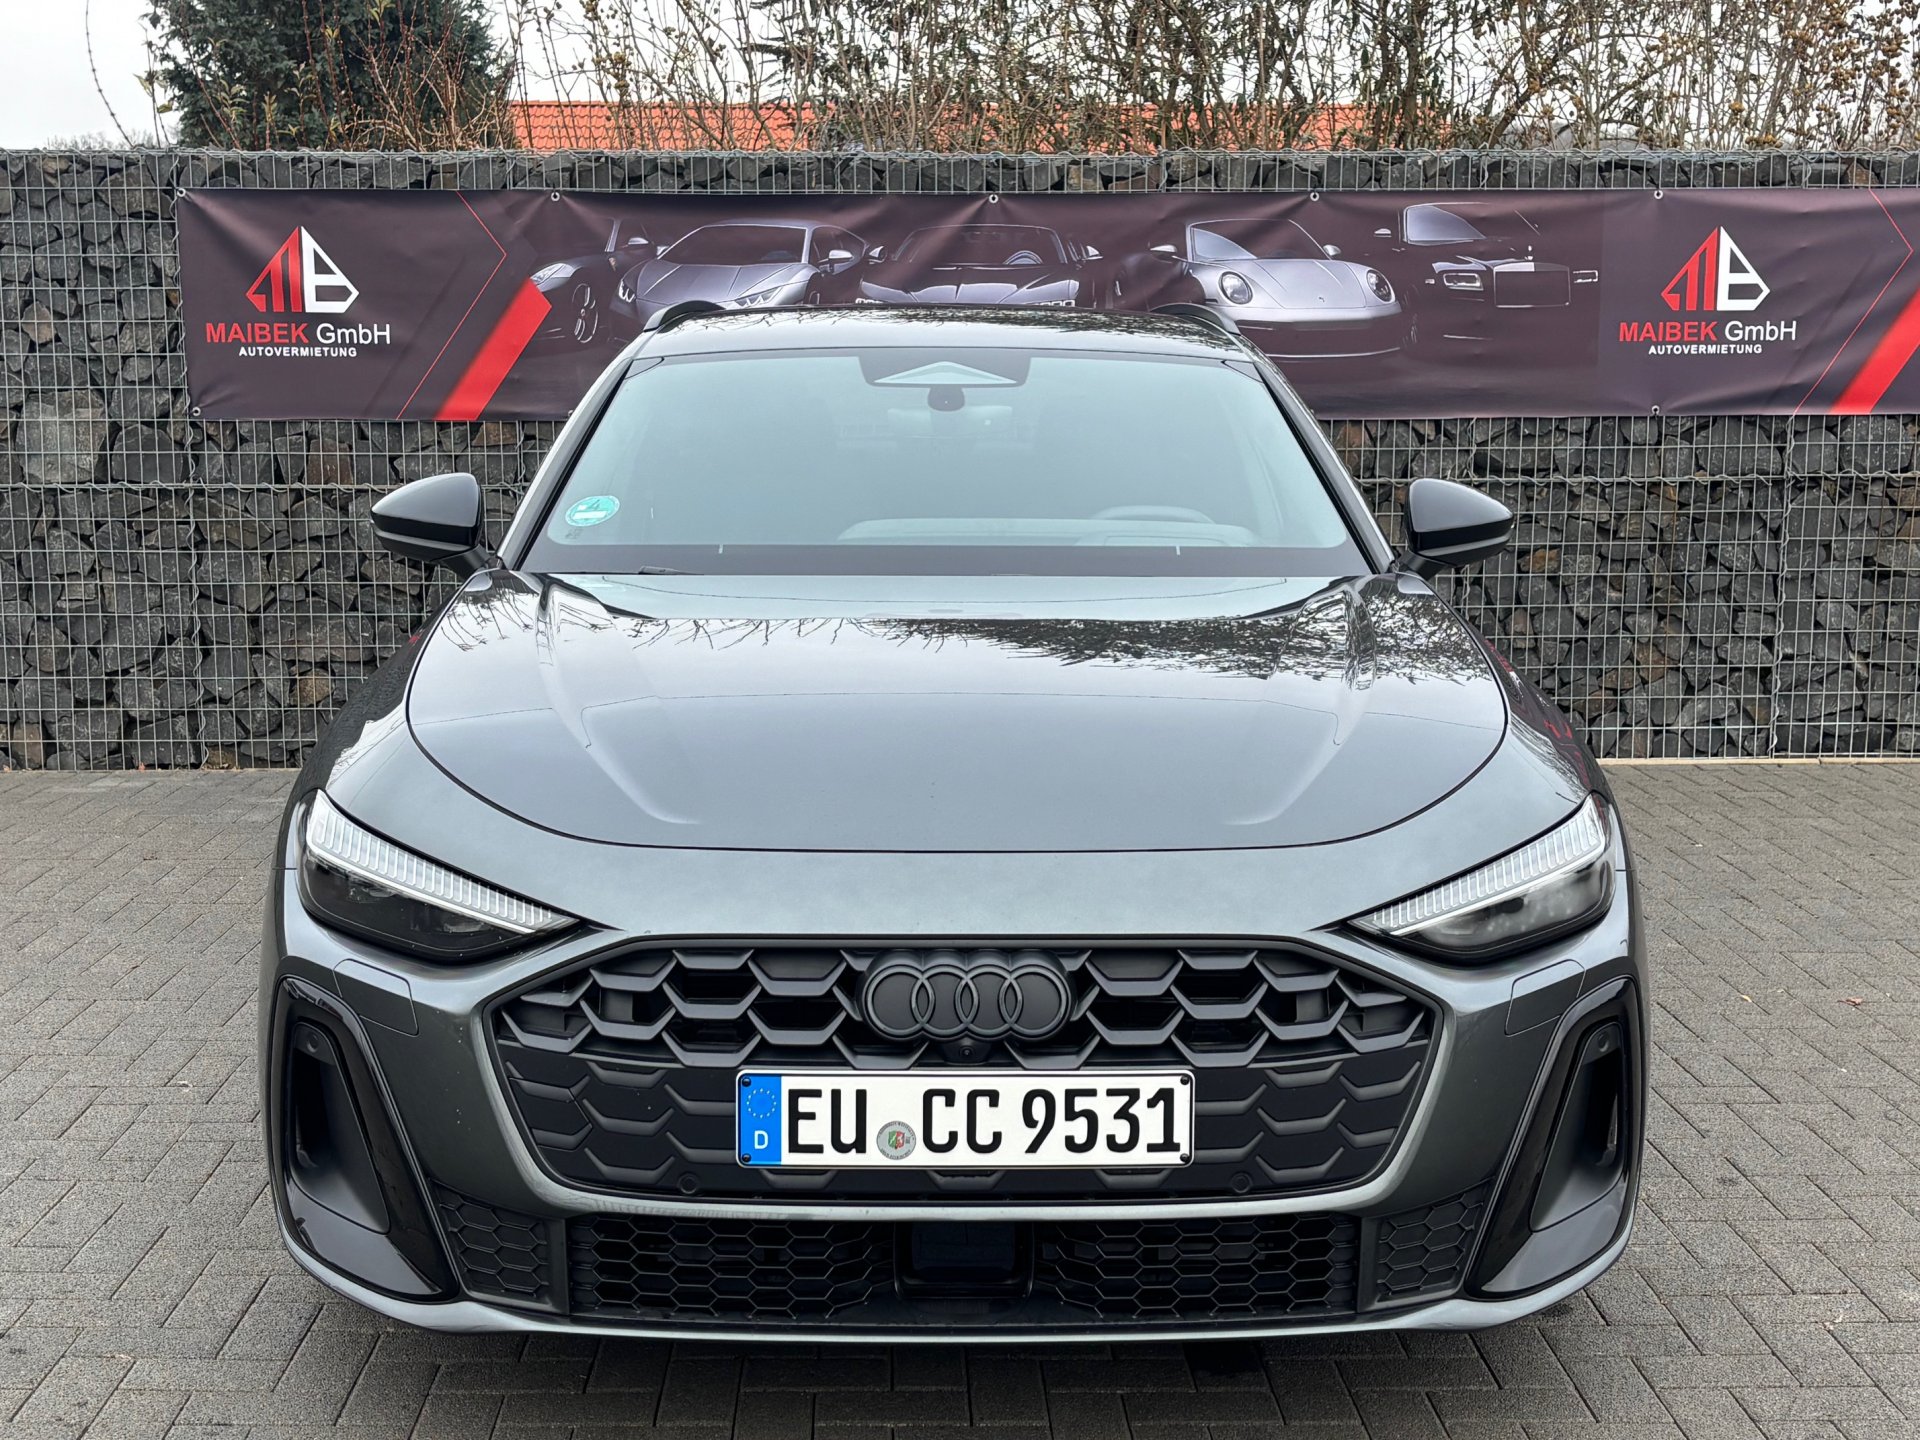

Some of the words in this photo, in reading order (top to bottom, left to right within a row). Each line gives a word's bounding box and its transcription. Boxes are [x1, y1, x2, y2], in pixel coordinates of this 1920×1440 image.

[206, 322, 309, 344] MAIBEK
[316, 323, 391, 345] GmbH
[1619, 321, 1718, 342] MAIBEK
[1724, 320, 1797, 342] GmbH
[239, 346, 357, 358] AUTOVERMIETUNG
[1648, 344, 1763, 356] AUTOVERMIETUNG
[787, 1088, 868, 1154] EU
[922, 1088, 1003, 1154] CC
[1021, 1087, 1181, 1155] 9531
[754, 1129, 769, 1150] D
